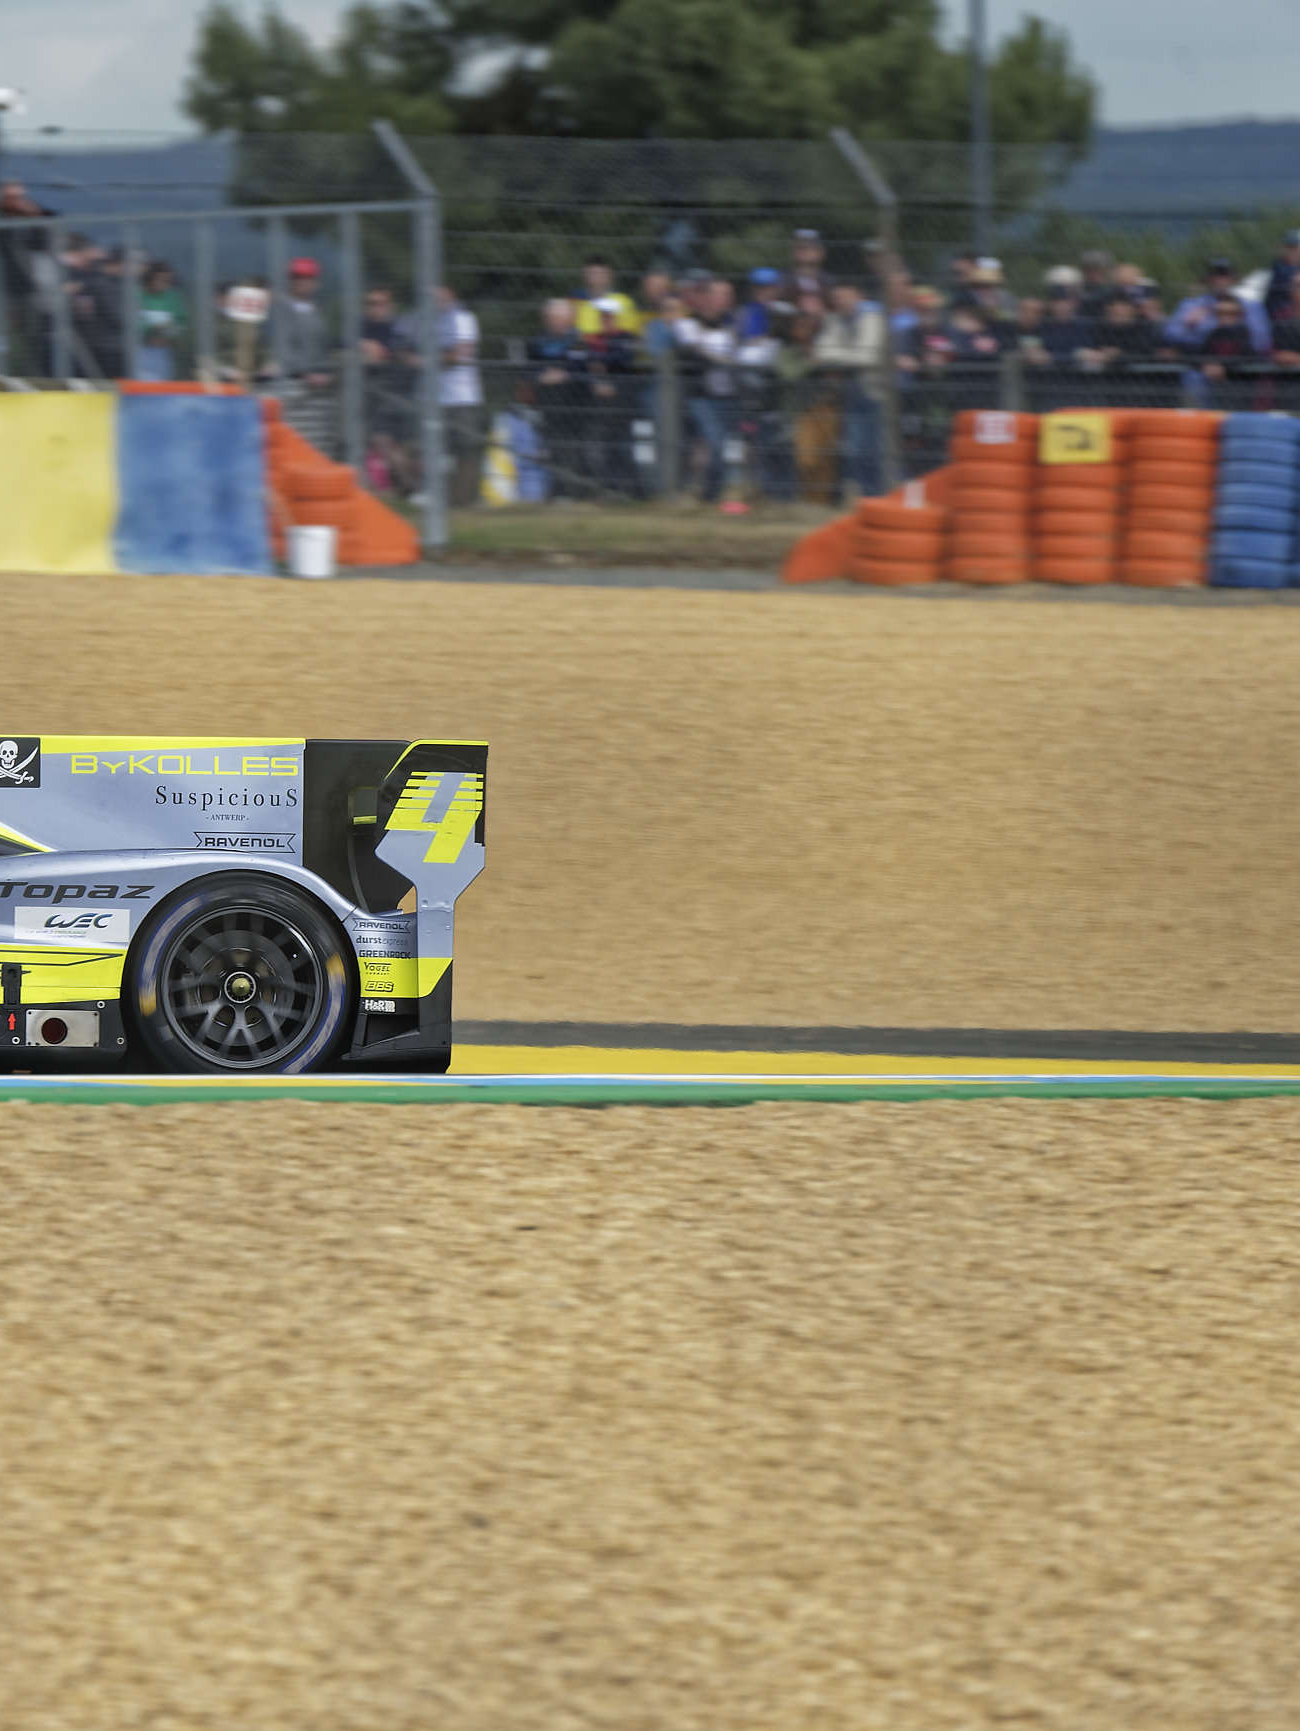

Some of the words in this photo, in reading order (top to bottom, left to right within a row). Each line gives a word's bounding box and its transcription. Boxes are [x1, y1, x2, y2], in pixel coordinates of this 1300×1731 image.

[155, 785, 298, 811] SuspiciouS
[203, 837, 286, 848] RAVENOL
[44, 912, 114, 929] WEC
[359, 921, 405, 930] RAVENOL
[364, 980, 395, 993] BBS
